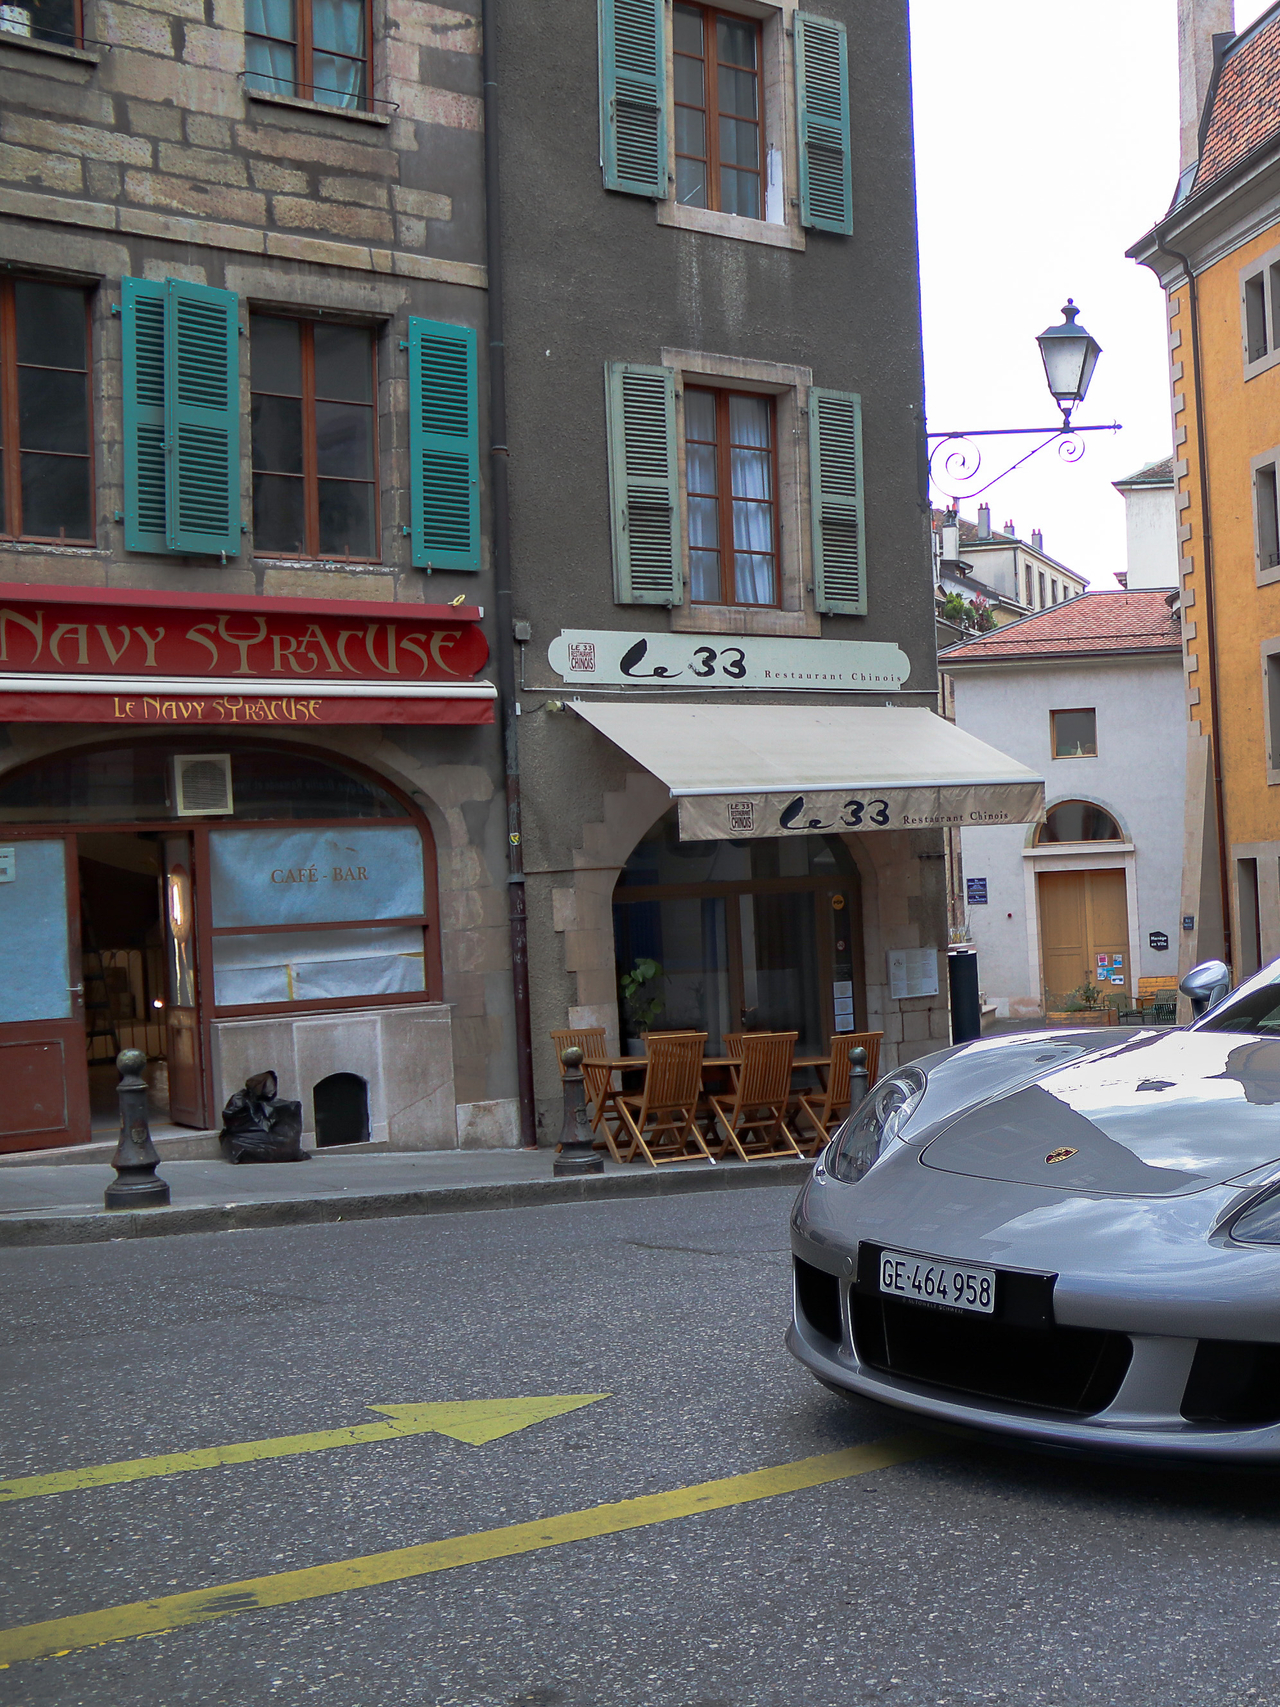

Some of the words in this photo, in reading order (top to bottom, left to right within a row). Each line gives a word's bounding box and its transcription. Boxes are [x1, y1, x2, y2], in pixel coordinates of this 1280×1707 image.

[688, 646, 747, 679] 33
[764, 669, 844, 681] Restaurant
[851, 672, 902, 682] Chinois
[143, 696, 205, 719] NAVY
[212, 696, 323, 722] SYRACUSE
[840, 800, 890, 827] 33
[903, 814, 964, 825] Restaurant
[970, 811, 1009, 822] Chinois
[271, 863, 319, 884] CAFÉ
[332, 866, 369, 882] BAR
[953, 1271, 992, 1307] 958
